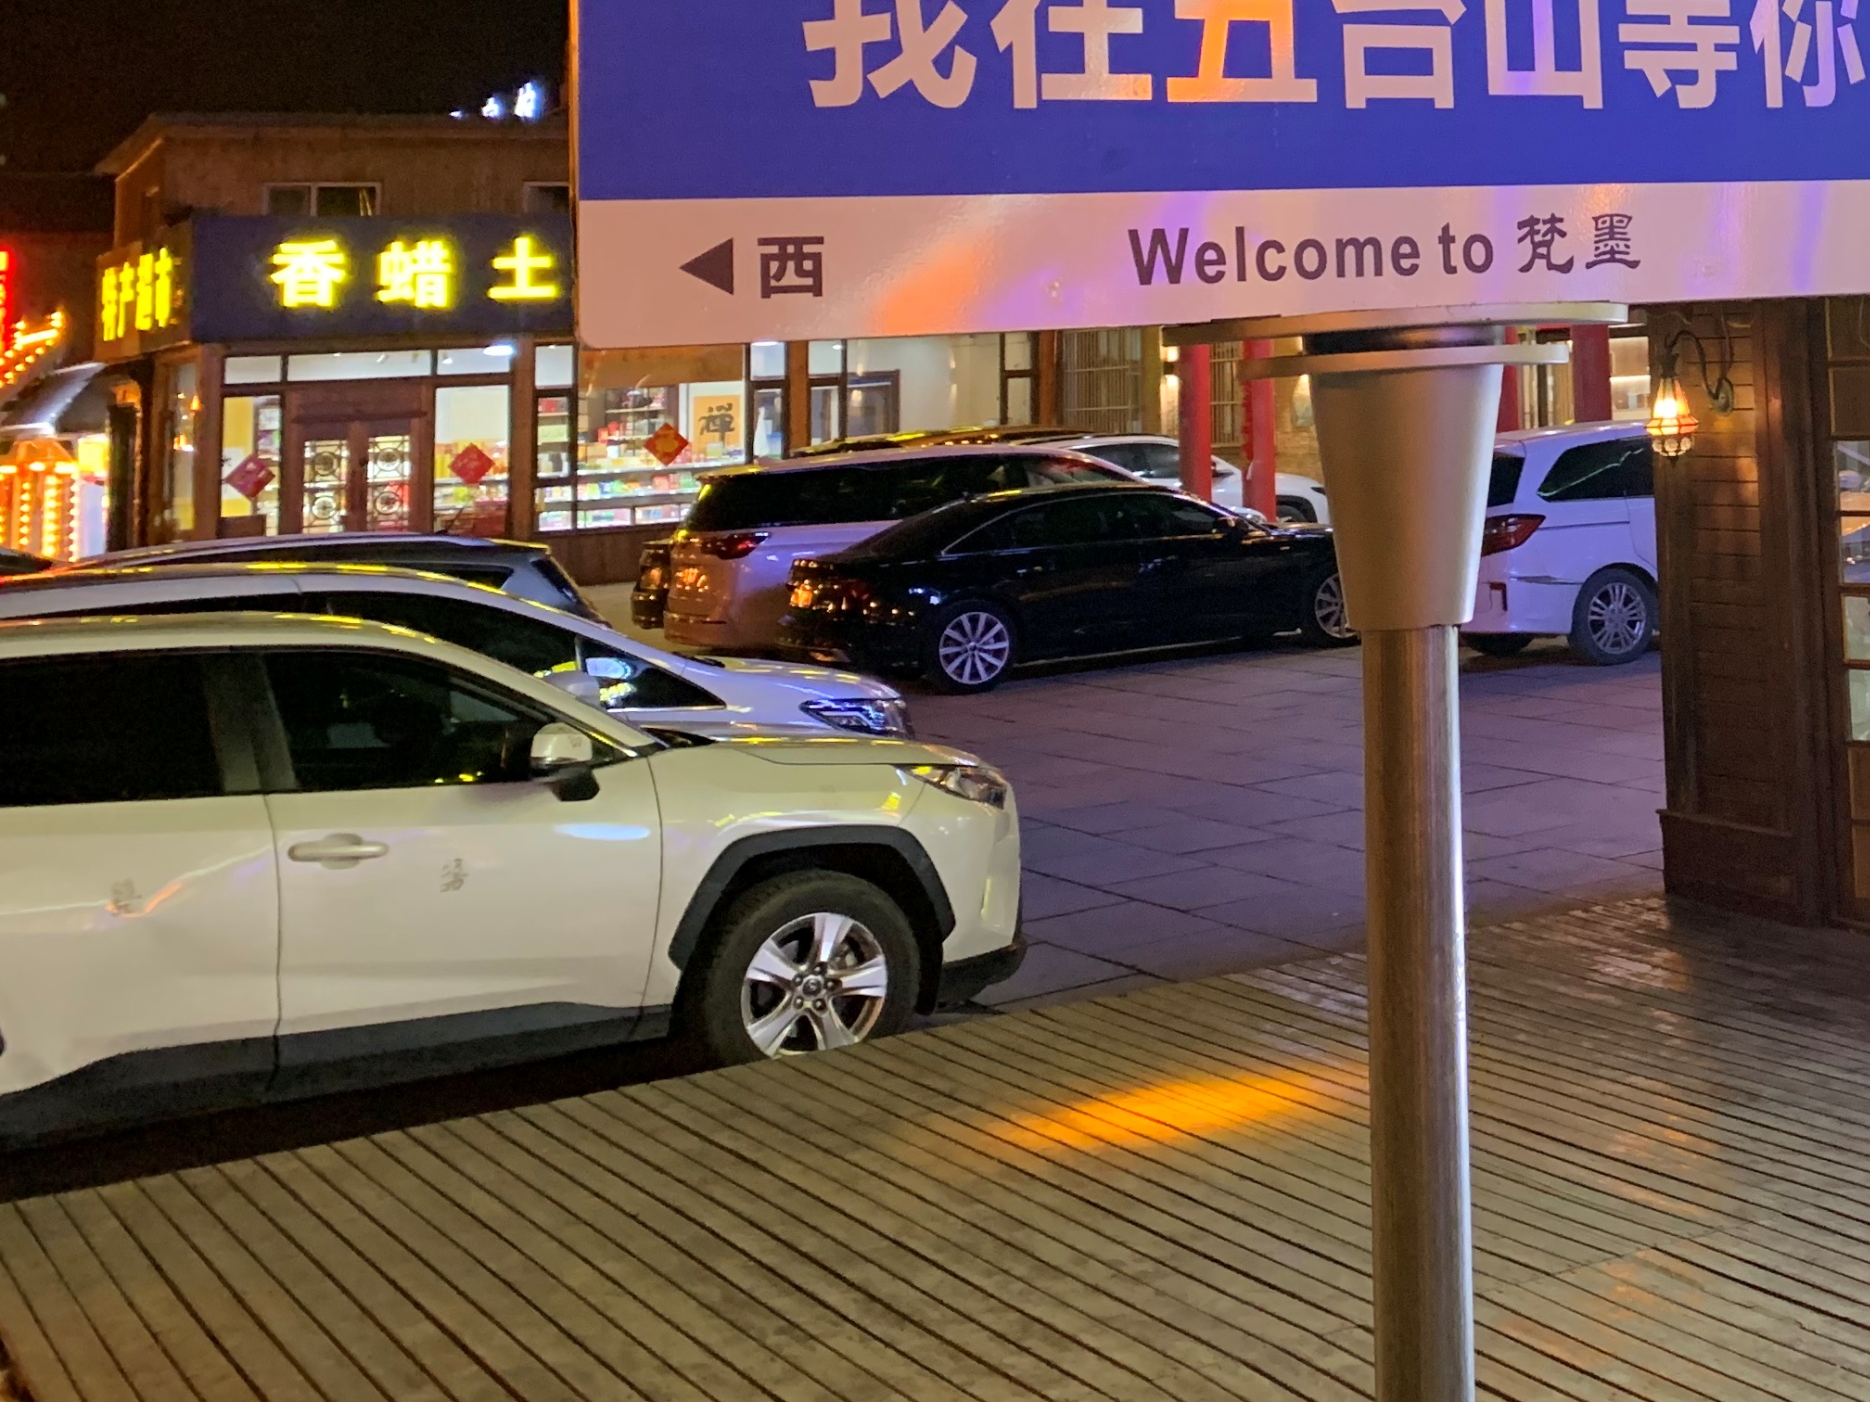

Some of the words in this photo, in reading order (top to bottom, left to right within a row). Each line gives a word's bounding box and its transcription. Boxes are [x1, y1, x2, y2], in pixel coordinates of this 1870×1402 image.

[269, 234, 560, 310] 香蜡土
[756, 235, 825, 299] 西
[1128, 218, 1422, 286] Welcome
[1437, 222, 1496, 277] to
[1516, 212, 1643, 275] 梵墨
